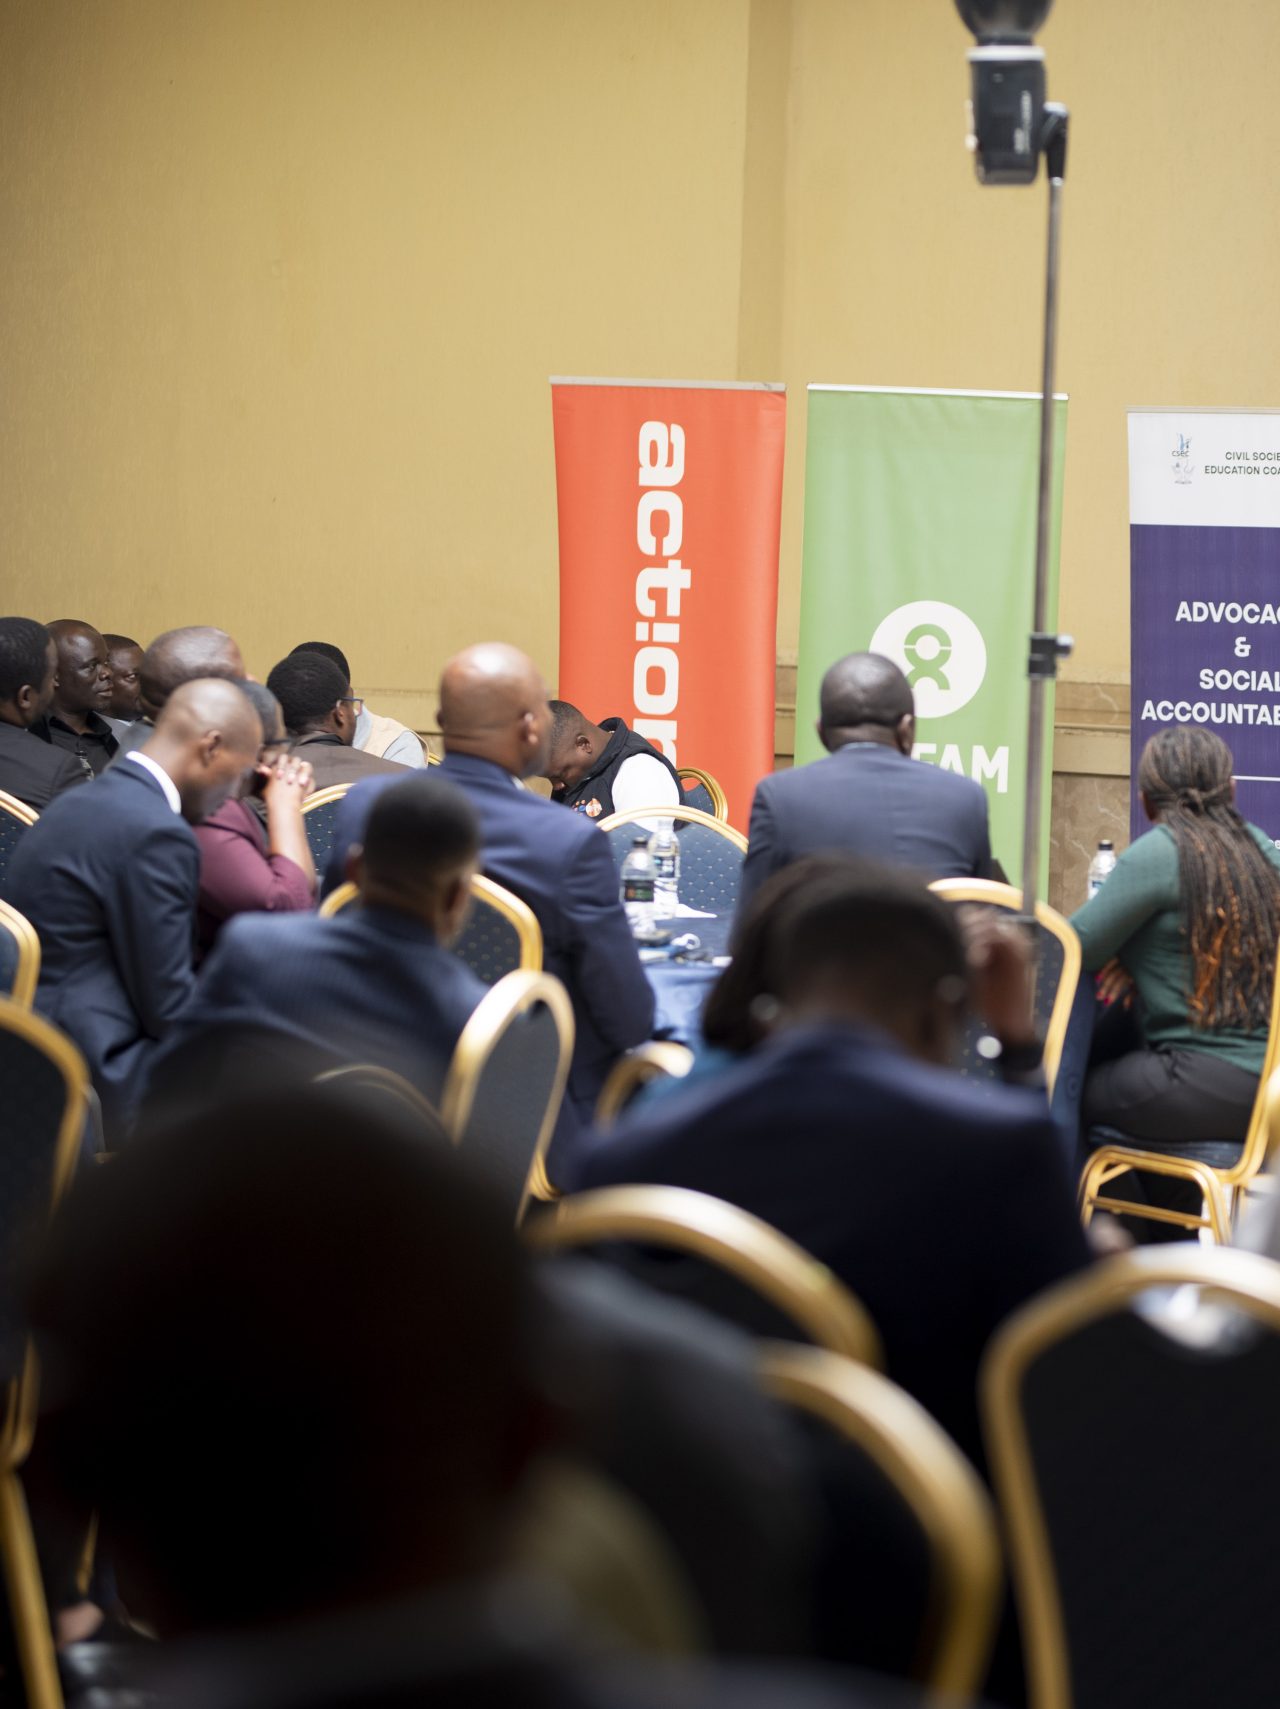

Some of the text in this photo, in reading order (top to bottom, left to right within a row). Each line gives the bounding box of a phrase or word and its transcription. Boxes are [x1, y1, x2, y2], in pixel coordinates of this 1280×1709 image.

[1225, 451, 1250, 461] CIVIL
[1204, 465, 1260, 475] EDUCATION
[1233, 636, 1251, 657] &
[911, 743, 1009, 793] FAM
